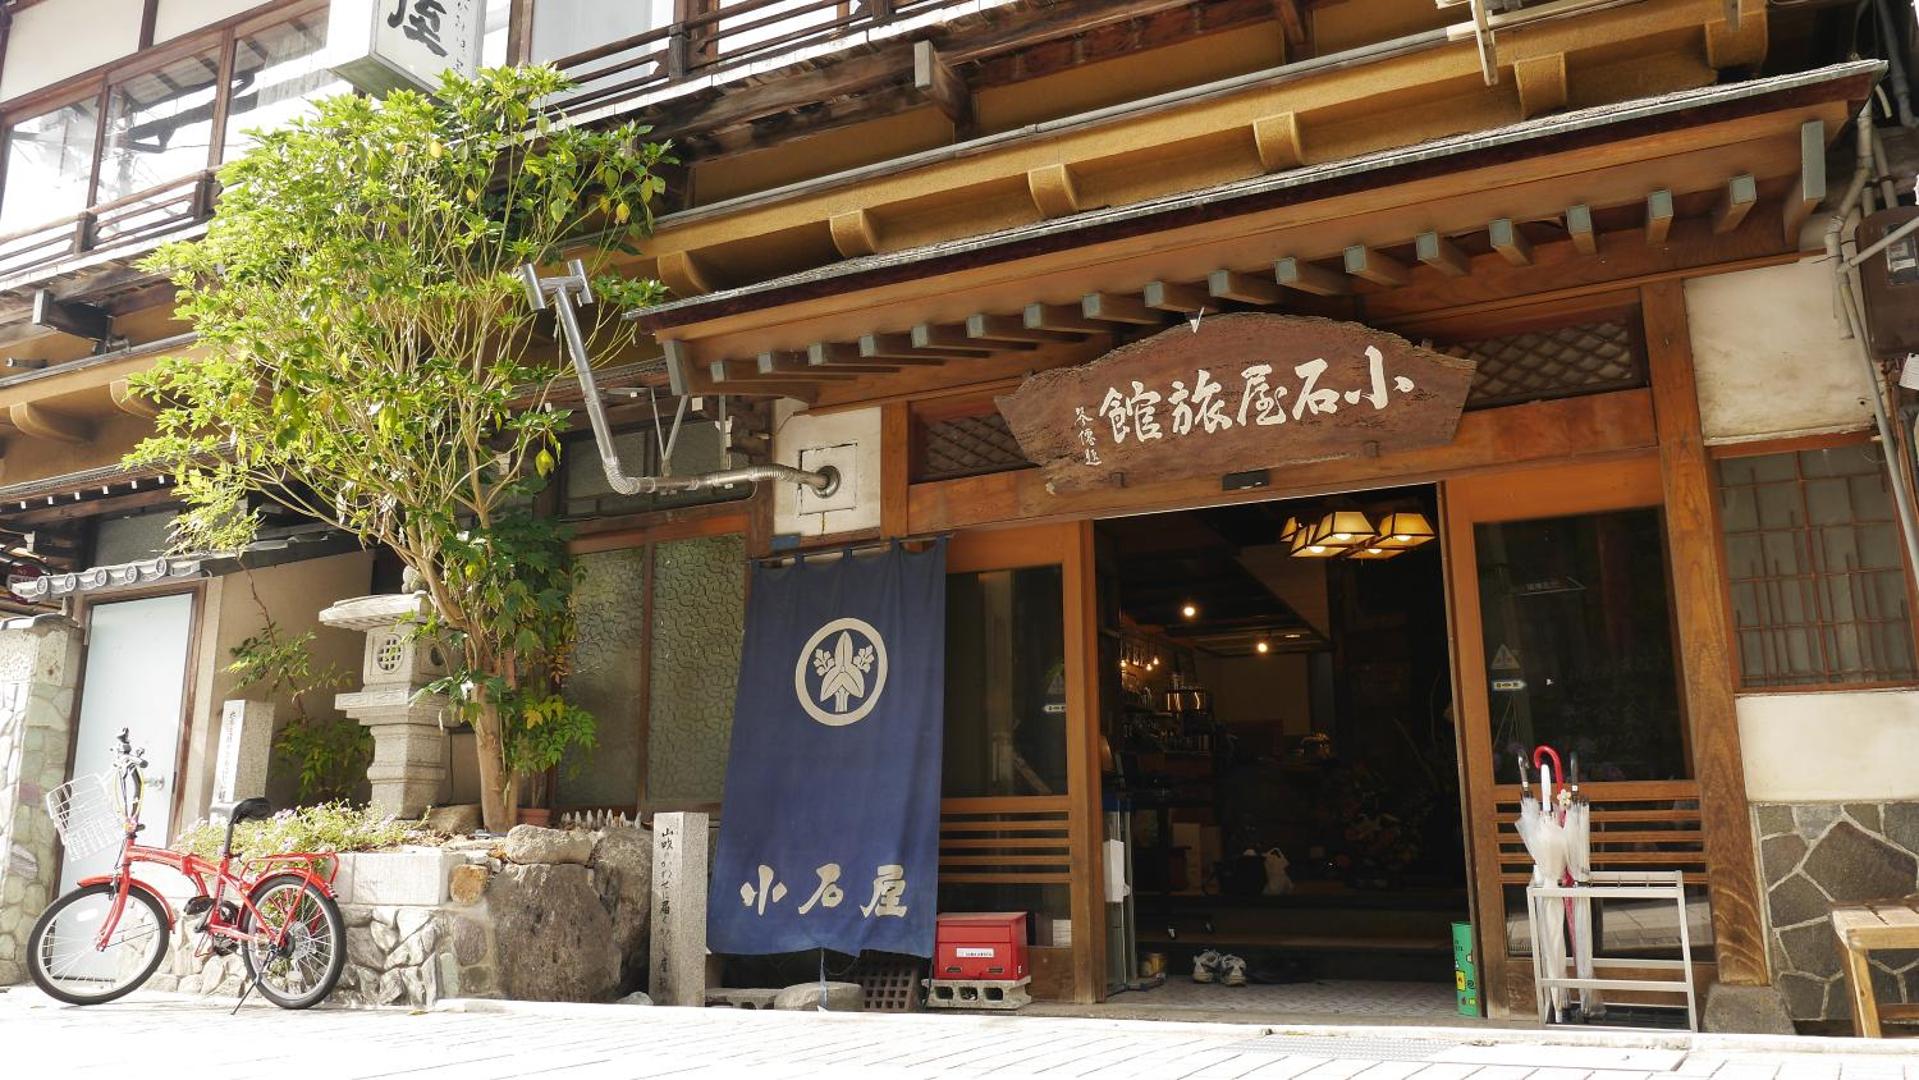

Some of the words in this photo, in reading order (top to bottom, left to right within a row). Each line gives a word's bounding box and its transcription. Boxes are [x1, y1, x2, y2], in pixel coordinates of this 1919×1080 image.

[1099, 345, 1416, 445] 小石屋旅館
[739, 863, 909, 919] 小石屋
